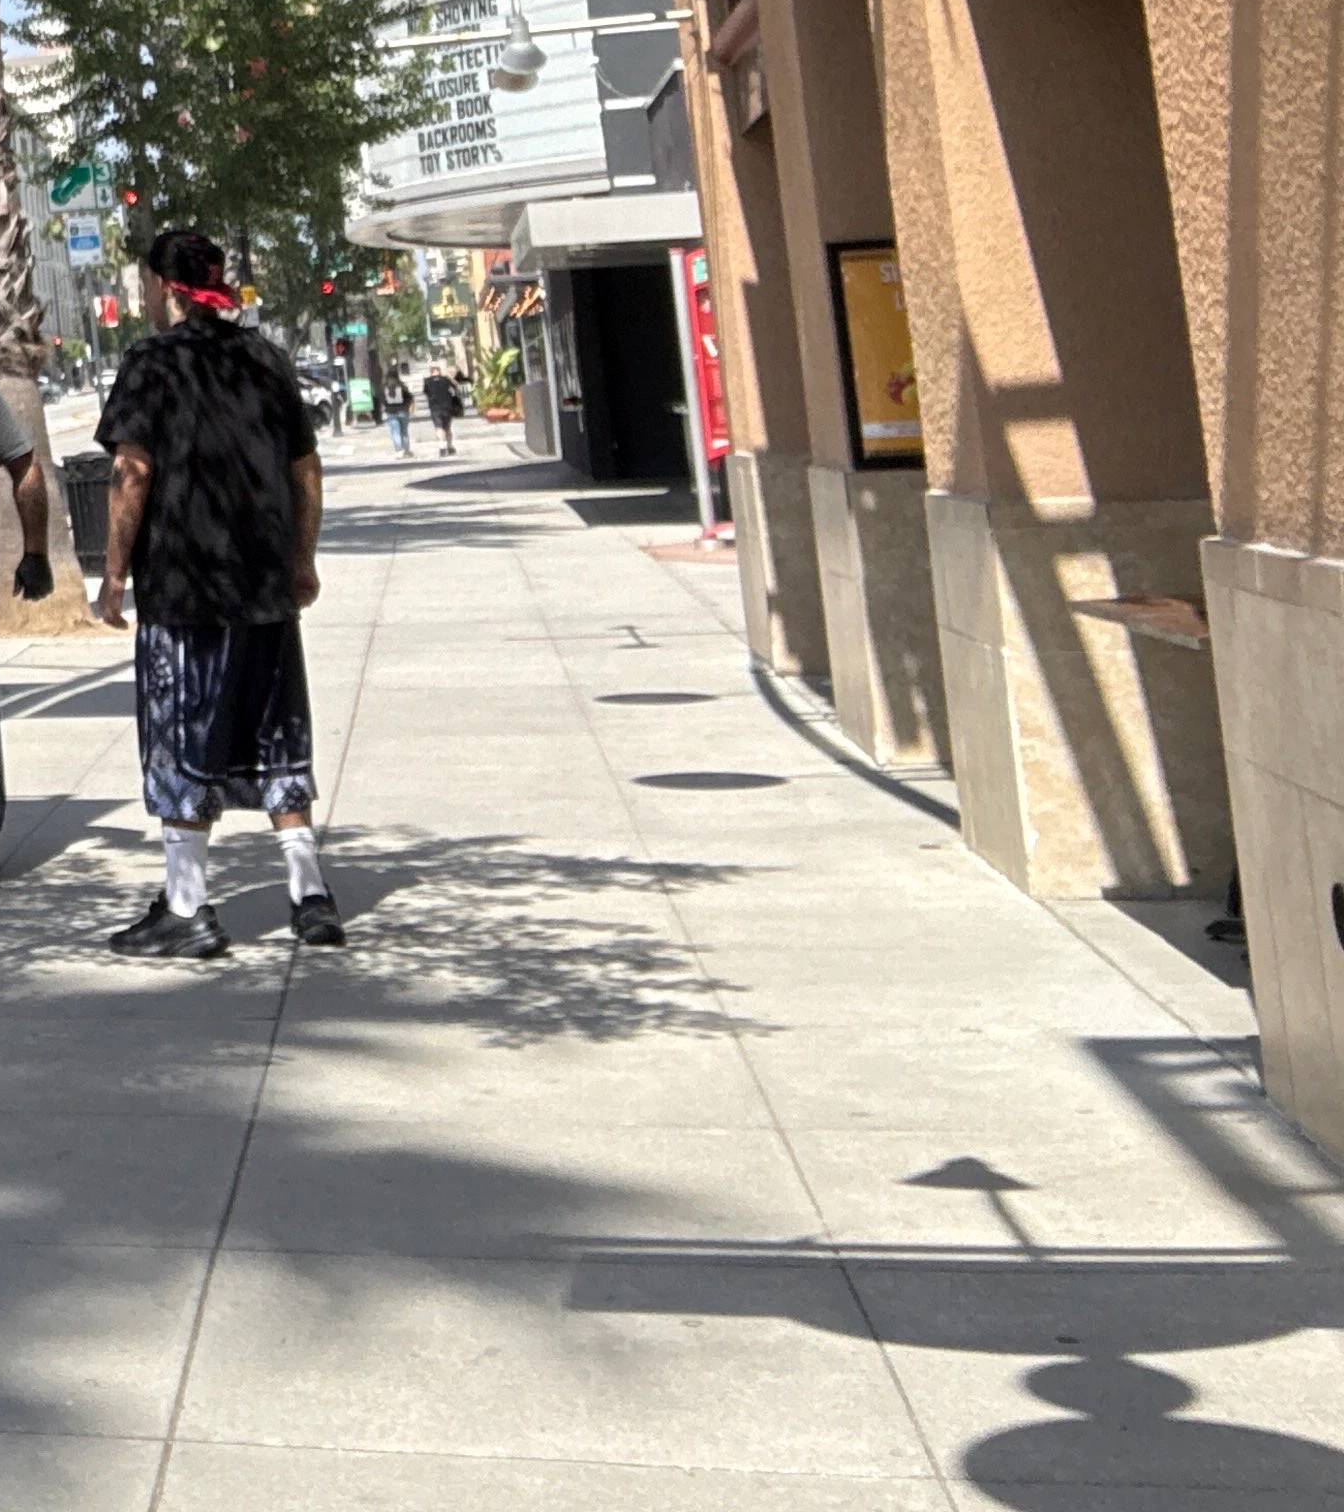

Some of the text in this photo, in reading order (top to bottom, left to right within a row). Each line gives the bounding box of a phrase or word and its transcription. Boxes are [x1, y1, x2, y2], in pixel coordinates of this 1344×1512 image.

[456, 93, 493, 120] BOOK
[417, 117, 497, 153] BACKROOMS
[419, 151, 441, 176] TOY
